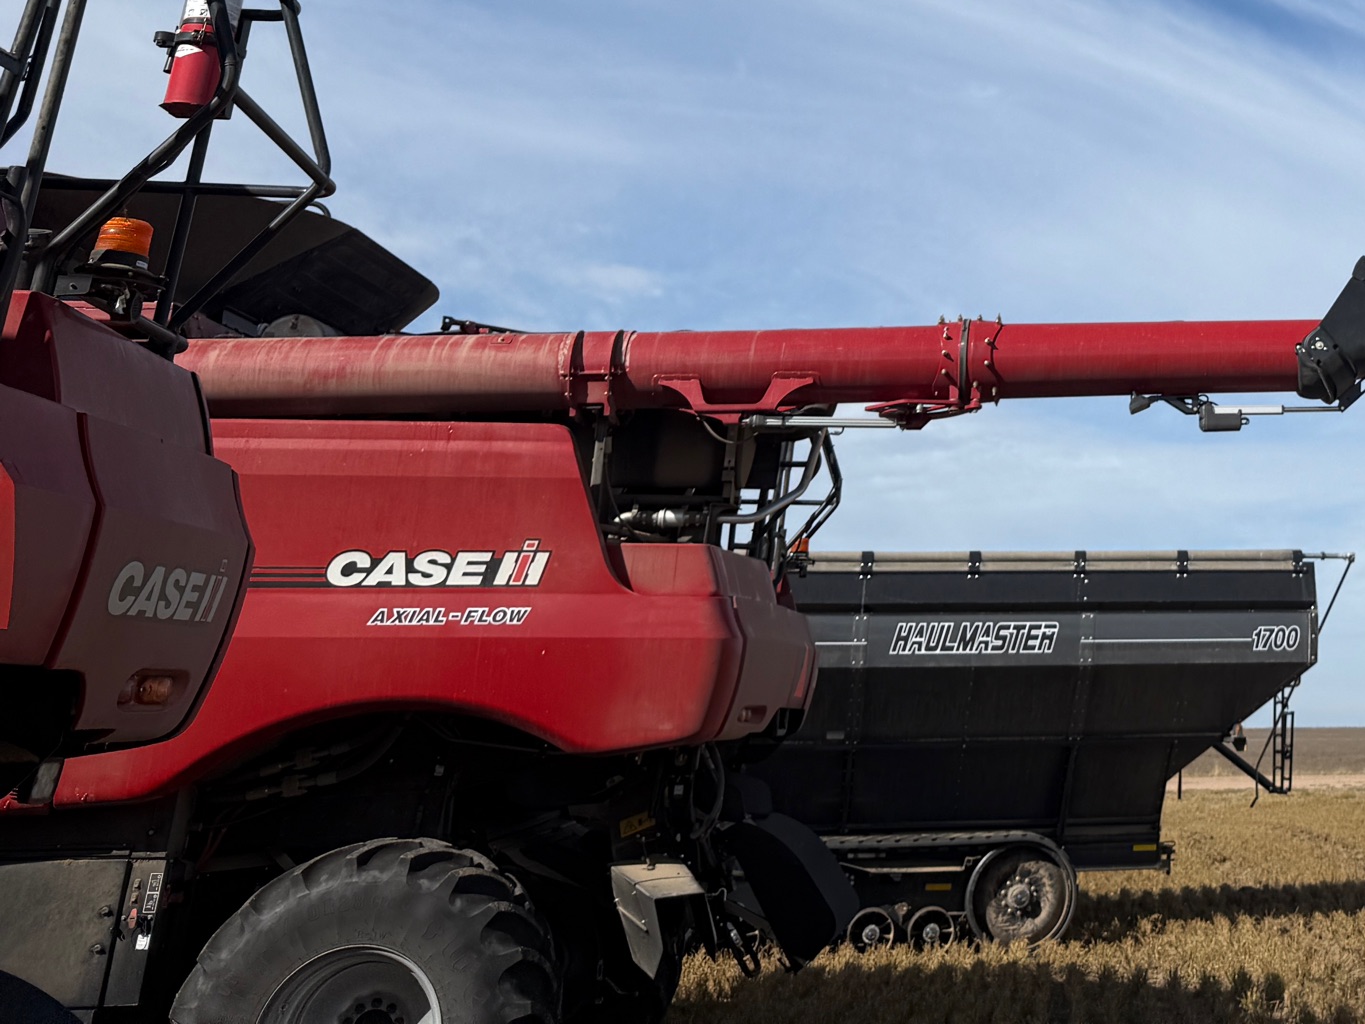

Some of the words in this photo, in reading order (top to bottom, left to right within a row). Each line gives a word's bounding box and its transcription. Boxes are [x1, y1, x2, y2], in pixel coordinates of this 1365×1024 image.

[325, 550, 493, 587] CASE
[107, 560, 207, 621] CASE
[889, 621, 1060, 655] HAULMASTER
[1252, 624, 1301, 651] 1700
